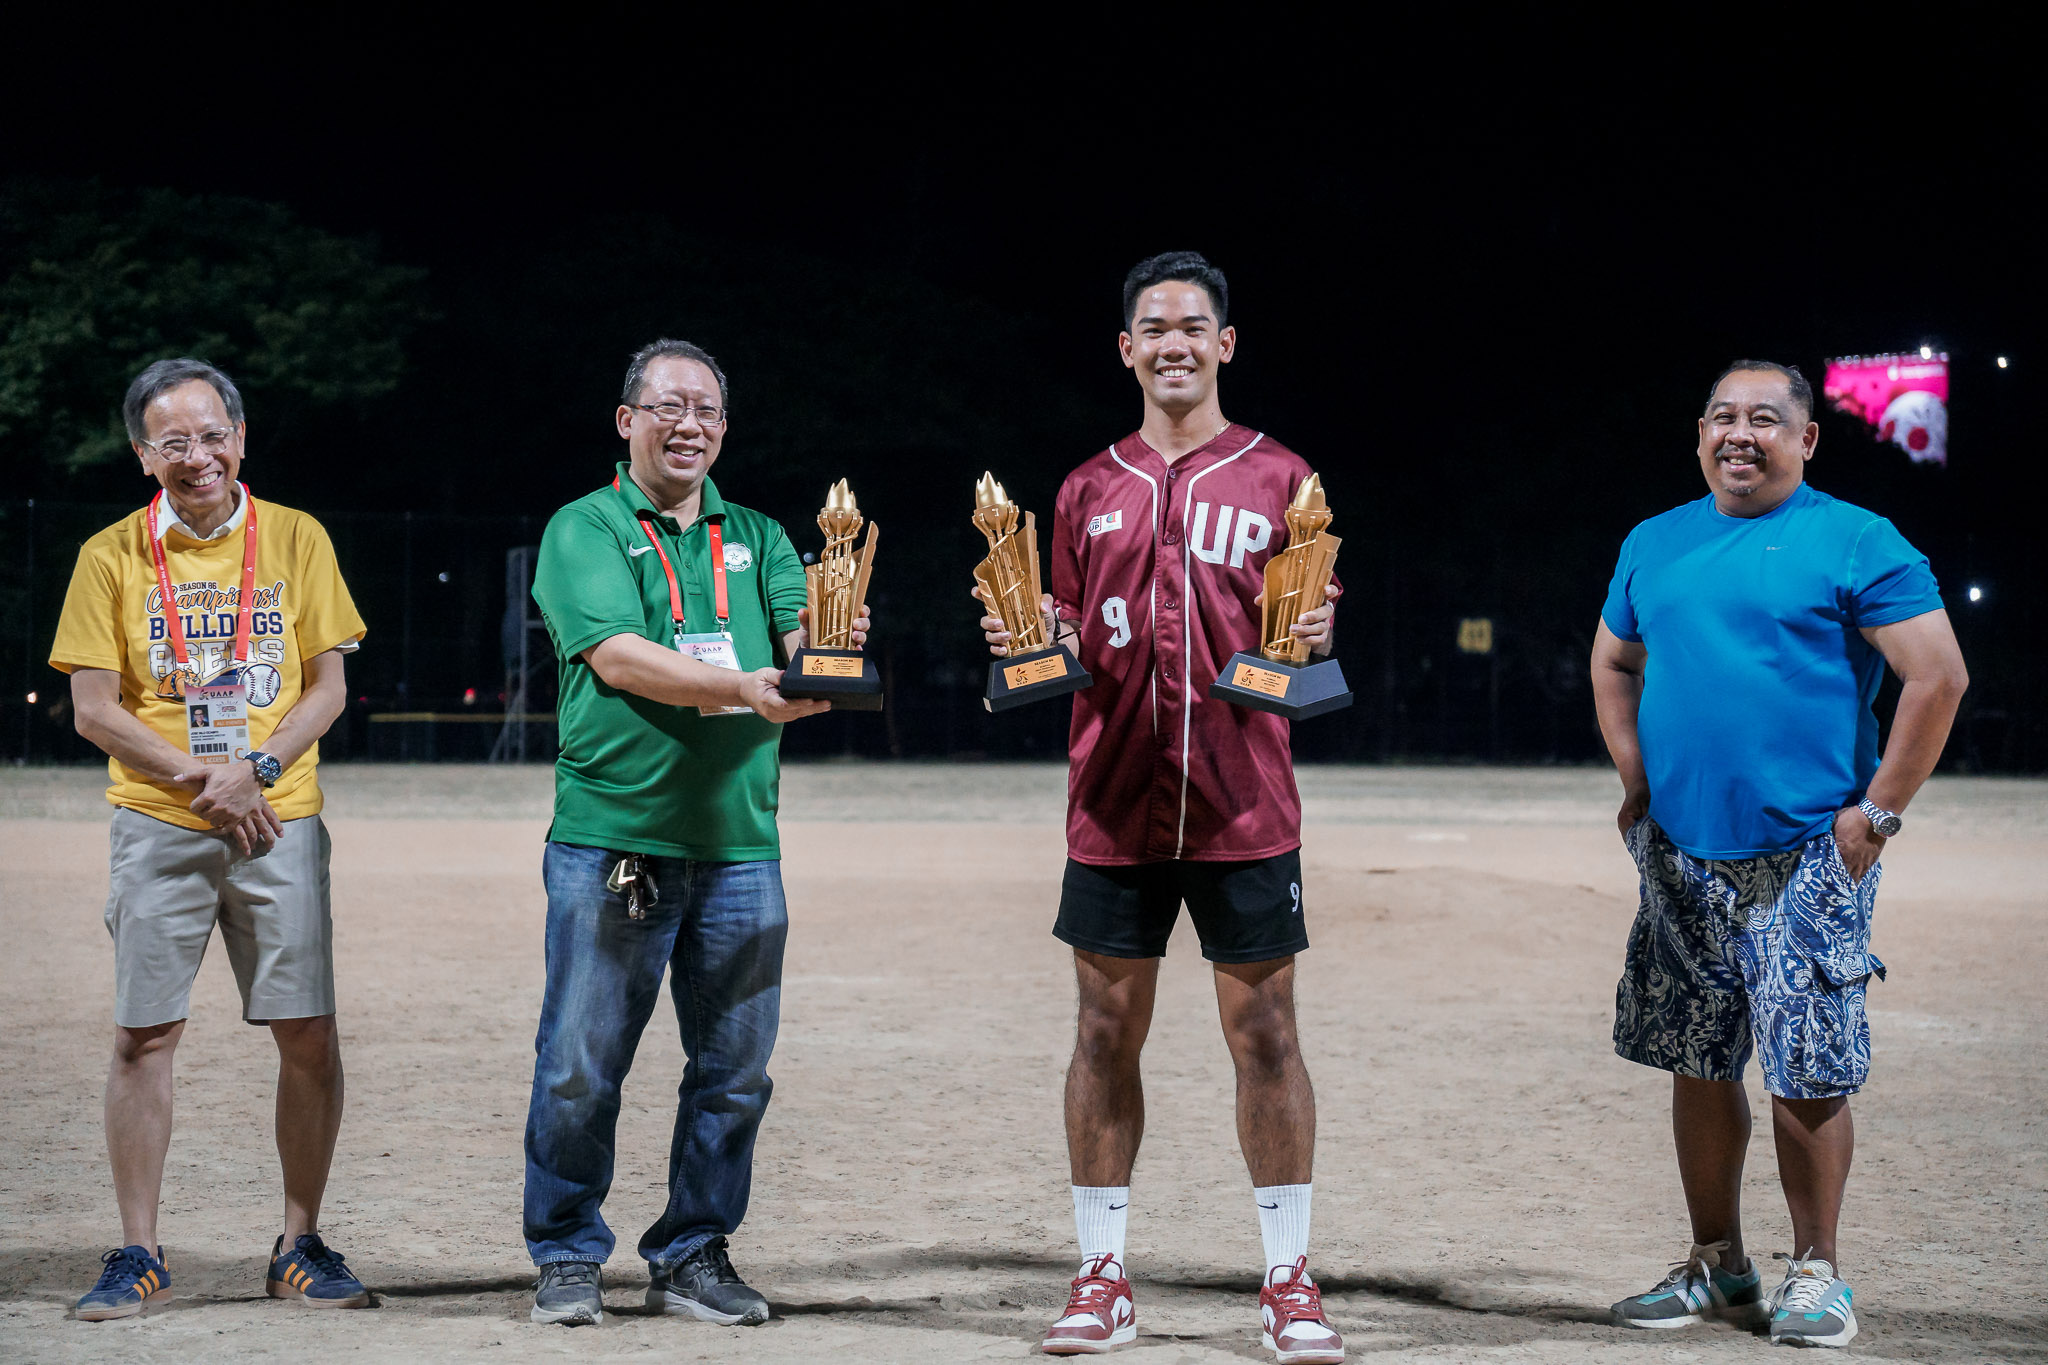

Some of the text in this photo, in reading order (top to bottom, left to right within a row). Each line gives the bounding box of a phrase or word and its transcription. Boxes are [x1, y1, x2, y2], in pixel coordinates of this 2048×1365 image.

[1190, 502, 1272, 568] UP
[147, 582, 283, 615] Campins!
[179, 582, 206, 591] SEASON
[150, 612, 283, 640] BLLDGS
[1101, 596, 1132, 648] 9
[235, 748, 244, 760] C
[1289, 882, 1300, 912] 9
